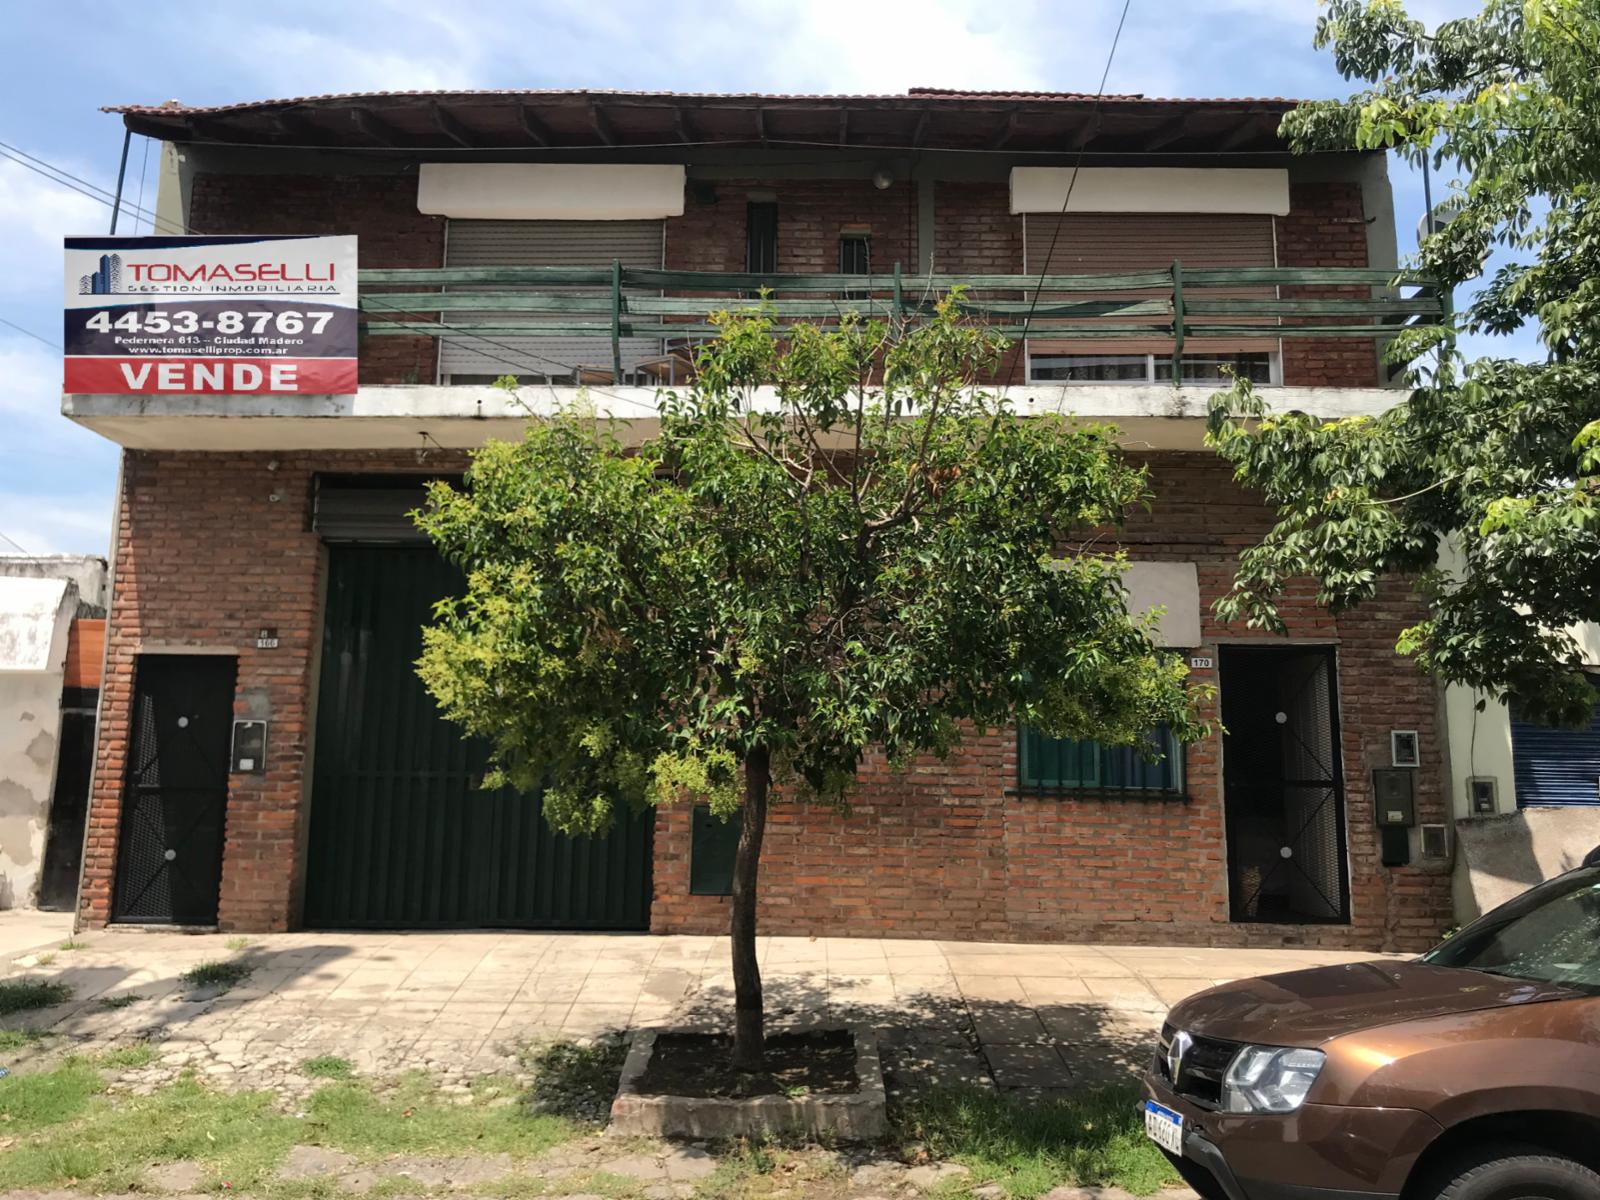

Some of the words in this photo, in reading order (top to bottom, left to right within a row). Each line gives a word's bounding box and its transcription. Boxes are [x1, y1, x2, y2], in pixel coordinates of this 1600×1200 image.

[127, 263, 335, 282] TOMASELLI
[127, 284, 202, 292] GESTION
[211, 284, 337, 292] INMOBILIARIA
[85, 310, 334, 335] 4453-8767
[114, 335, 175, 345] Pedernera
[178, 335, 201, 345] 613
[213, 336, 256, 346] Ciudad
[258, 336, 304, 346] Madero
[128, 345, 289, 356] www.tomaselliprop.com.ar
[120, 362, 299, 391] VENDE
[1193, 658, 1210, 667] 170
